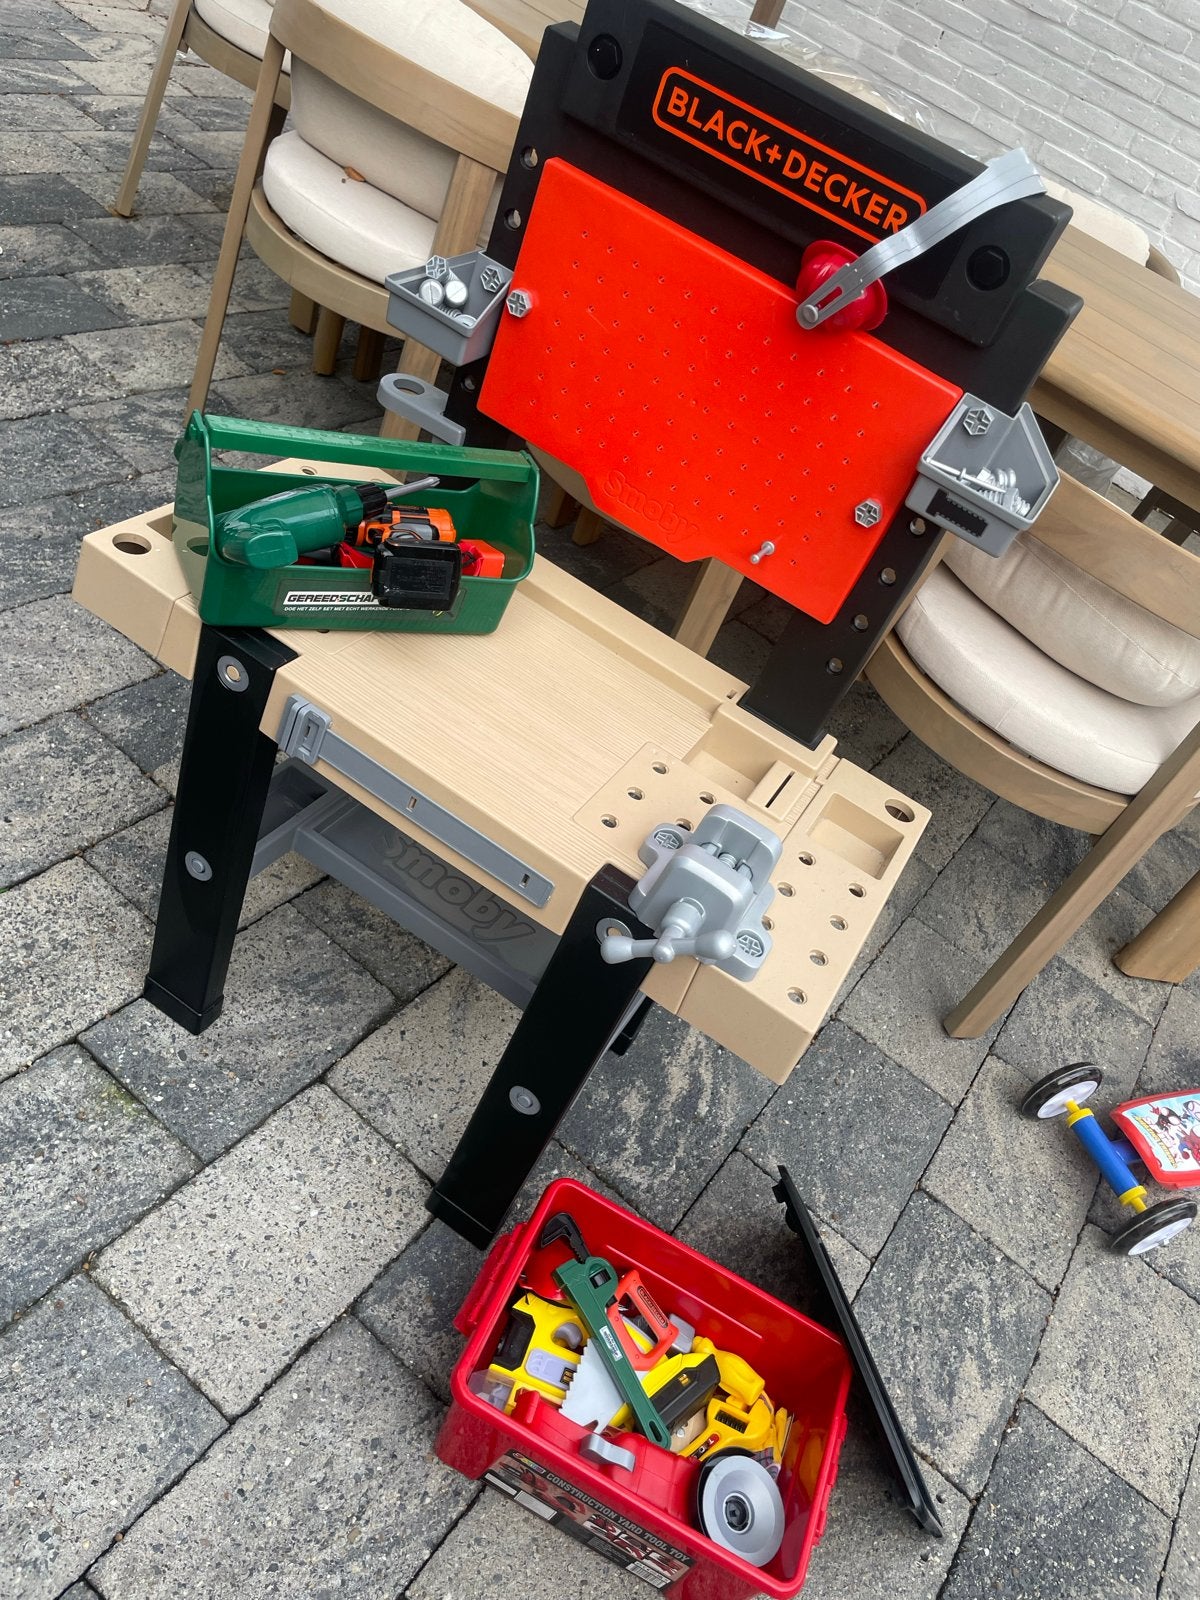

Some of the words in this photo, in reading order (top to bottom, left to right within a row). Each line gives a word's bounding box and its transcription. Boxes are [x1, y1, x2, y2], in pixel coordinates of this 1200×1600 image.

[666, 86, 908, 233] BLACK+DECKER
[602, 469, 700, 544] Smoby
[546, 1473, 618, 1519] CONSTRUCTION
[617, 1517, 642, 1535] YARD
[644, 1531, 667, 1551] TOOL
[669, 1547, 691, 1562] TOY
